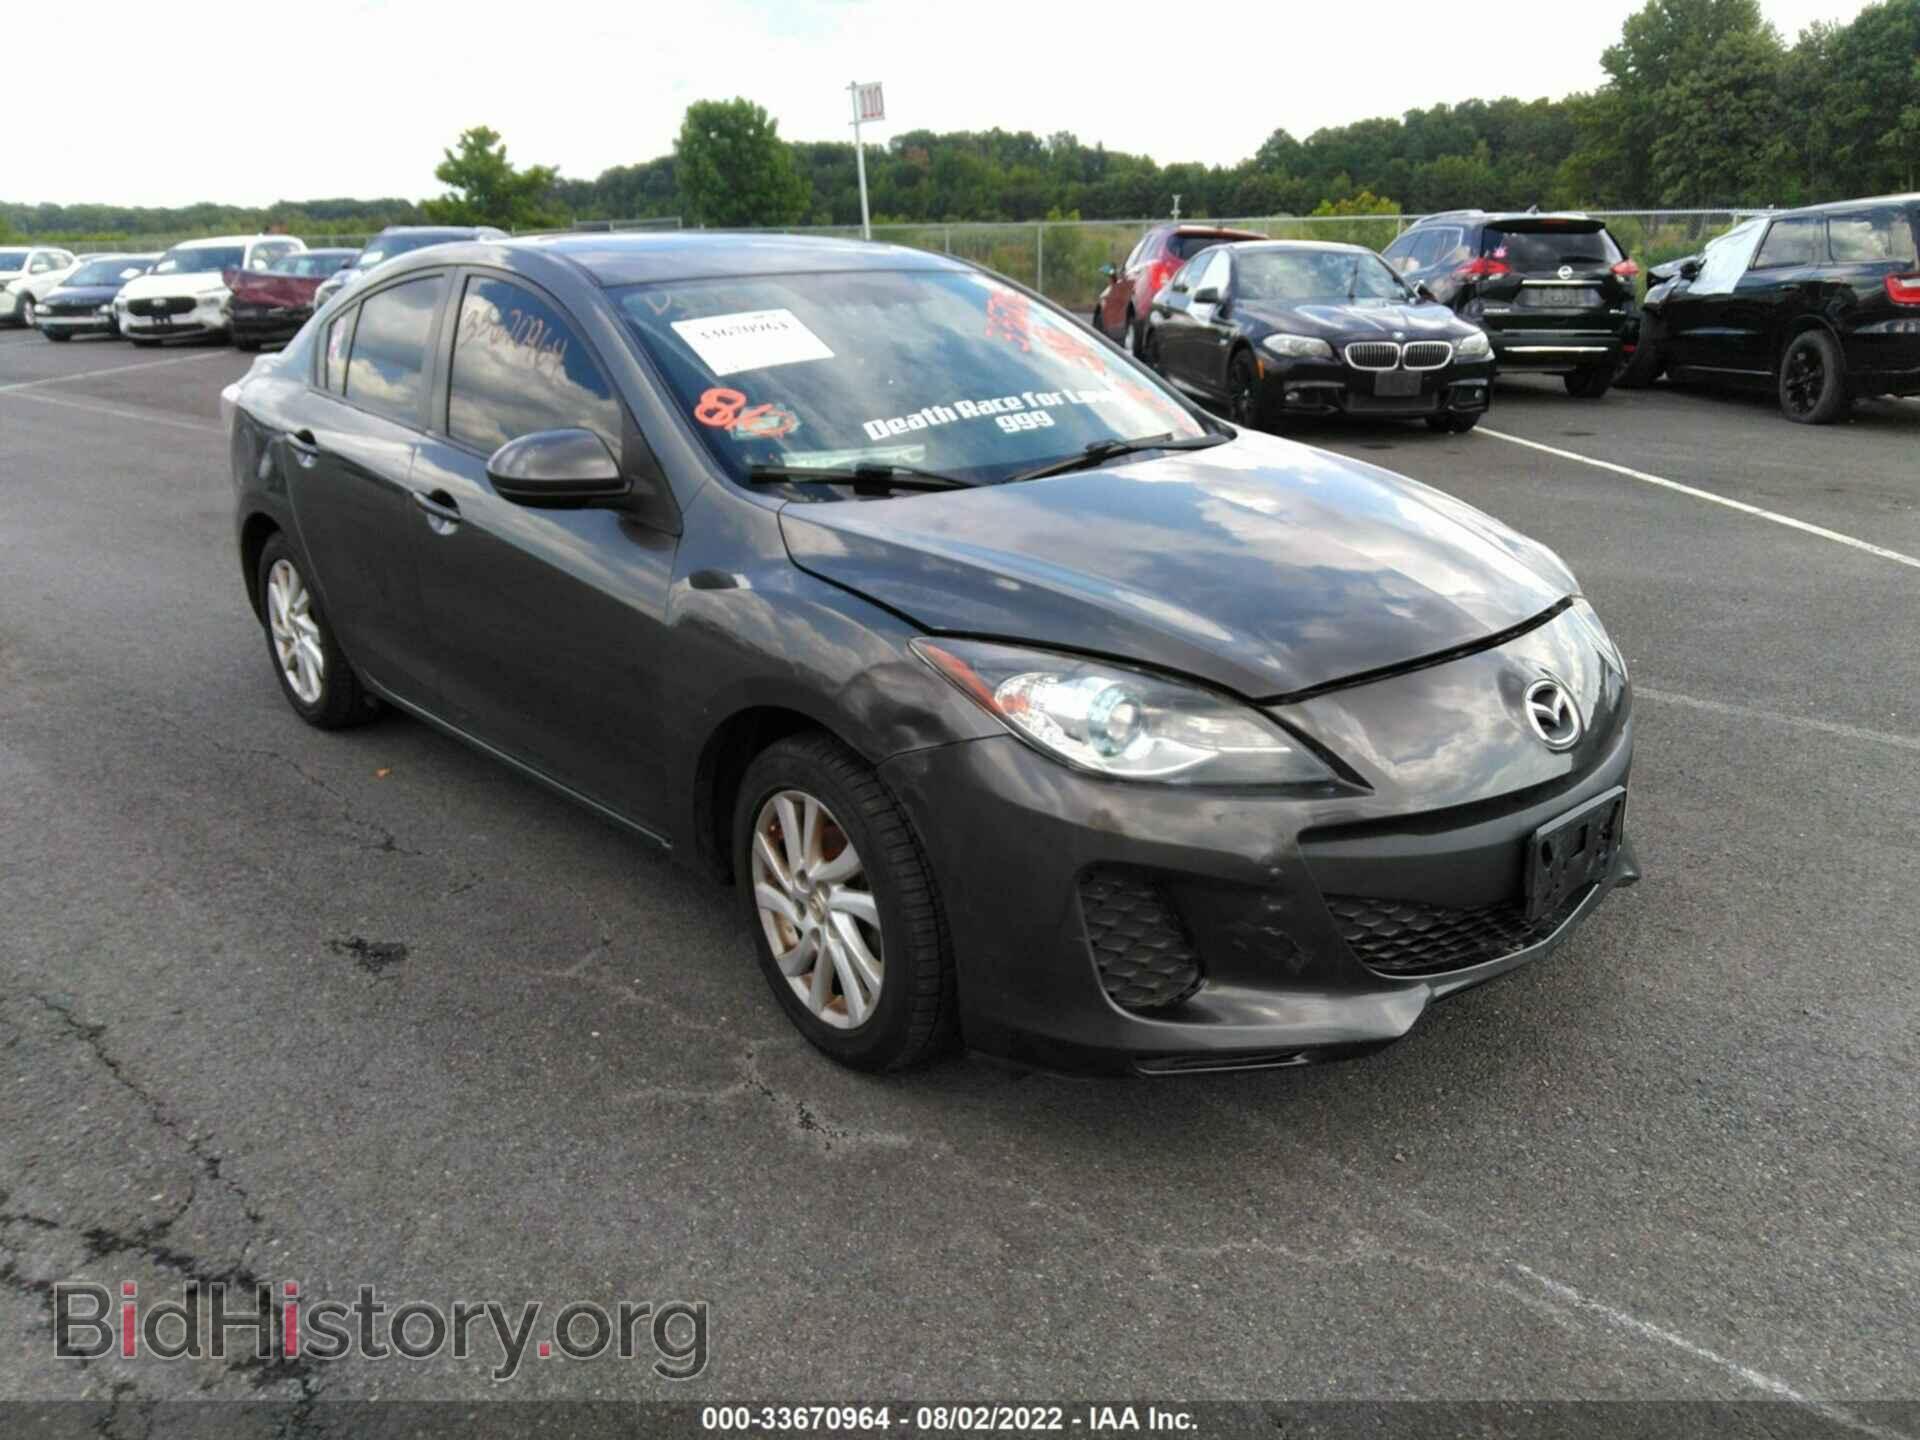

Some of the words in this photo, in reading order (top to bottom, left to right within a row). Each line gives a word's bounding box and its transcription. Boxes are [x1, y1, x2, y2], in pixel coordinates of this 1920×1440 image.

[863, 405, 959, 440] Death
[954, 396, 1025, 419] Race
[1021, 390, 1065, 408] for
